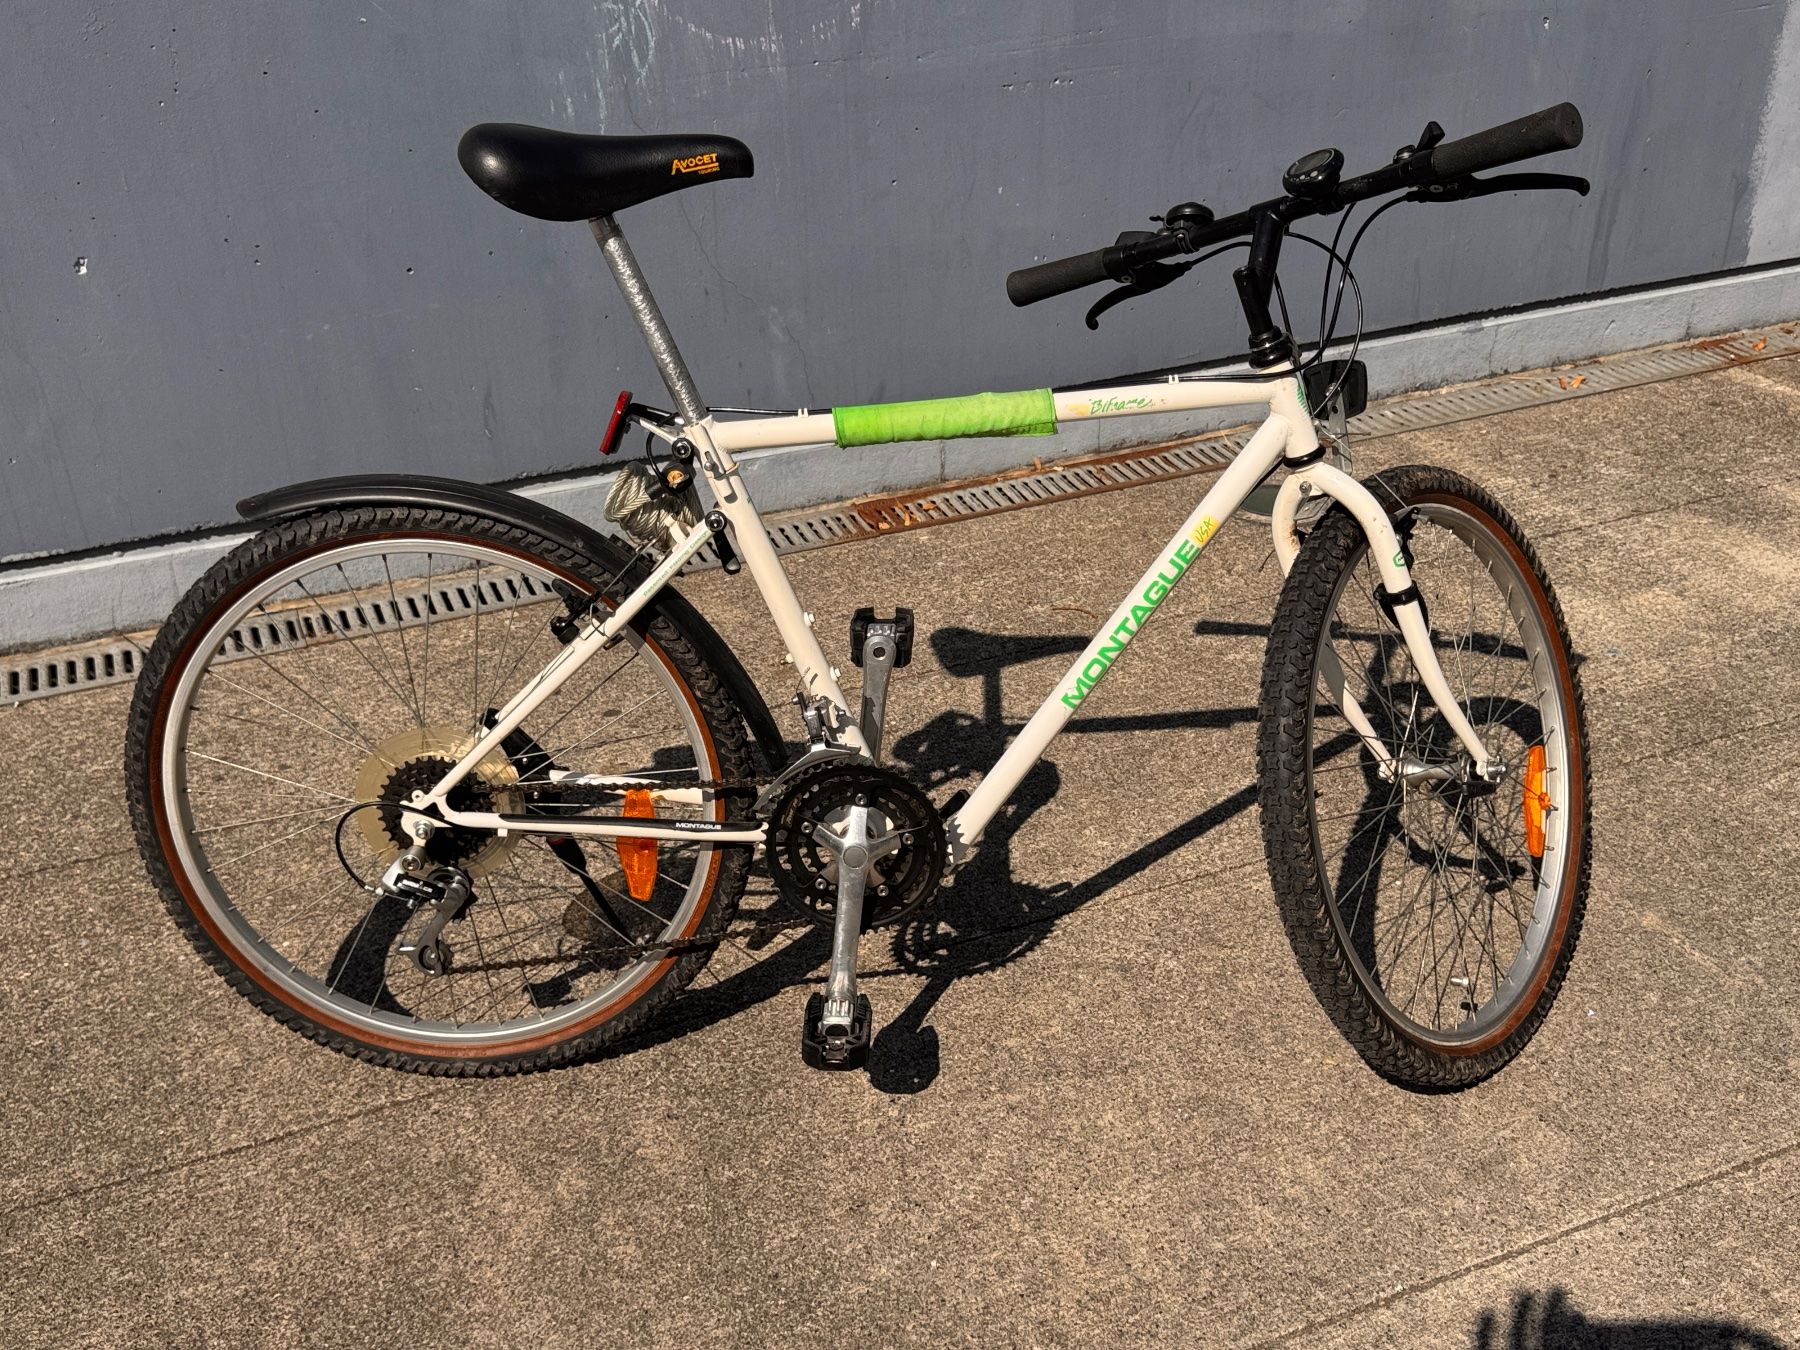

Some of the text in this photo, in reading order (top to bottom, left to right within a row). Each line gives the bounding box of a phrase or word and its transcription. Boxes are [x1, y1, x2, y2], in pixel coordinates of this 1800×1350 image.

[671, 153, 718, 175] AVOCET
[1061, 517, 1214, 710] MONTAGUE USA
[675, 822, 722, 830] MONTAGUE
